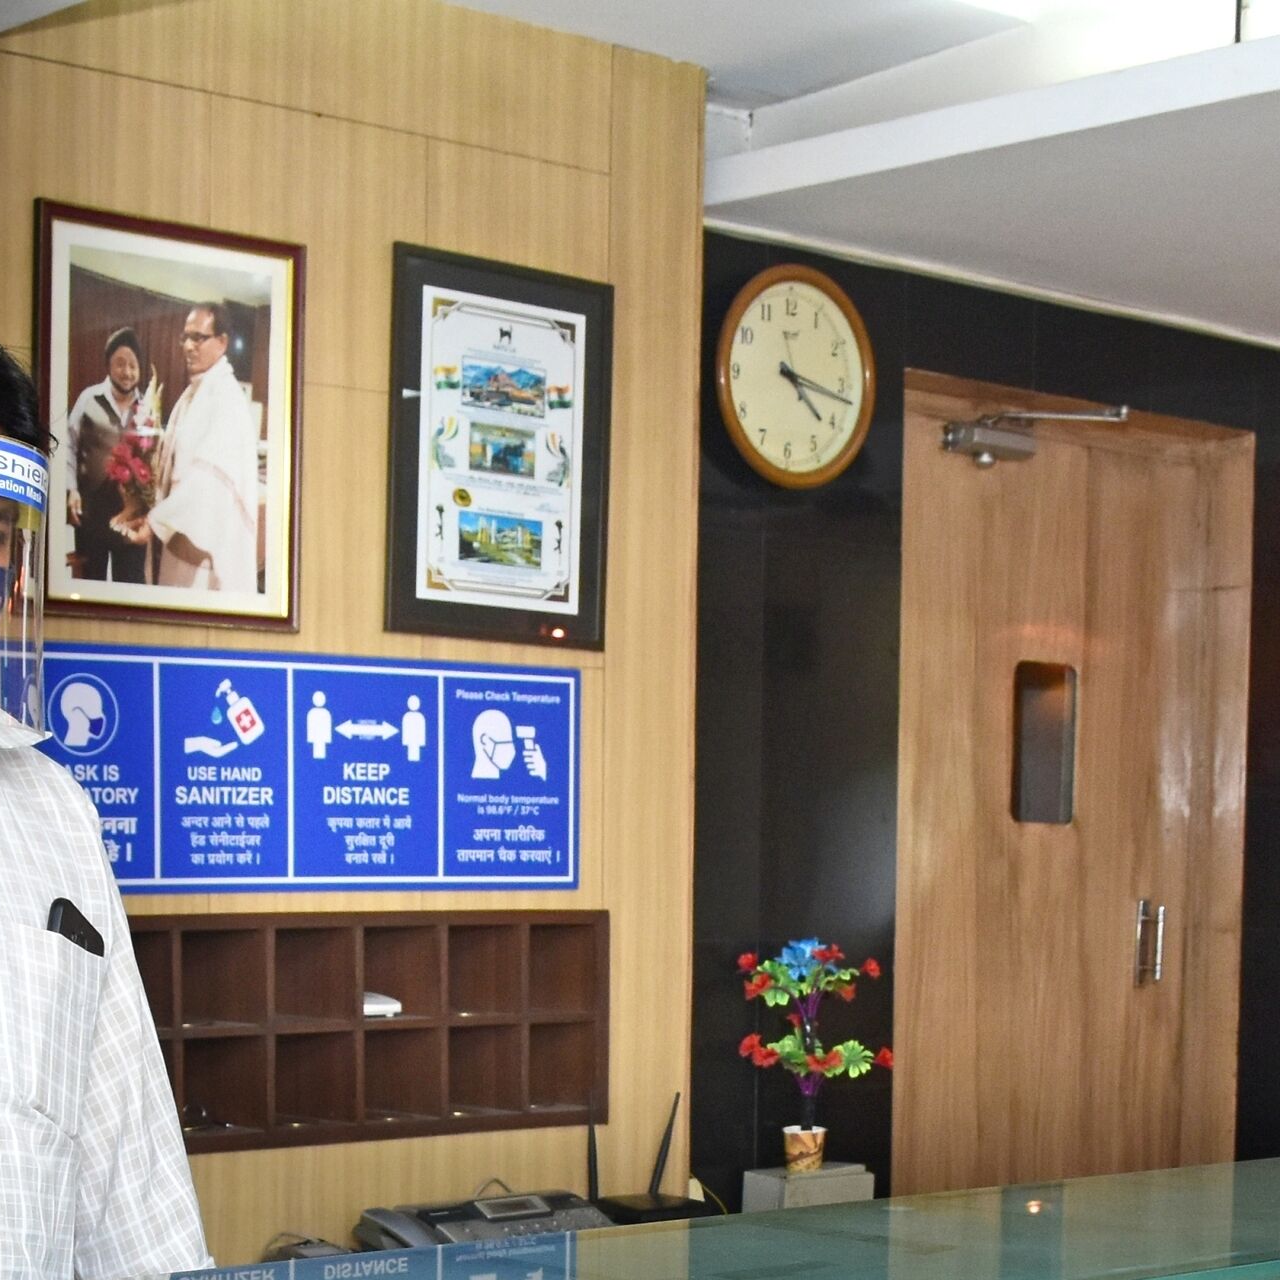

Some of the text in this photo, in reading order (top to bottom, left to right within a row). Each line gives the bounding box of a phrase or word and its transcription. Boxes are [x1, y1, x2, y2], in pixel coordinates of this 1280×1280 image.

[761, 303, 771, 320] 11
[786, 298, 798, 316] 12
[741, 327, 754, 344] 10
[732, 363, 740, 379] 9
[738, 401, 747, 419] 8
[829, 412, 836, 430] 4
[758, 428, 766, 446] 7
[810, 435, 818, 452] 5
[784, 442, 792, 459] 6
[456, 688, 560, 704] Please Check Temperature
[102, 764, 120, 782] IS
[187, 766, 262, 782] USE HAND
[343, 762, 390, 781] KEEP
[175, 785, 274, 806] SANITIZER
[323, 786, 410, 806] DISTANCE
[457, 794, 560, 805] Normal body temperature
[473, 828, 501, 842] अपना
[456, 848, 494, 862] तापमान
